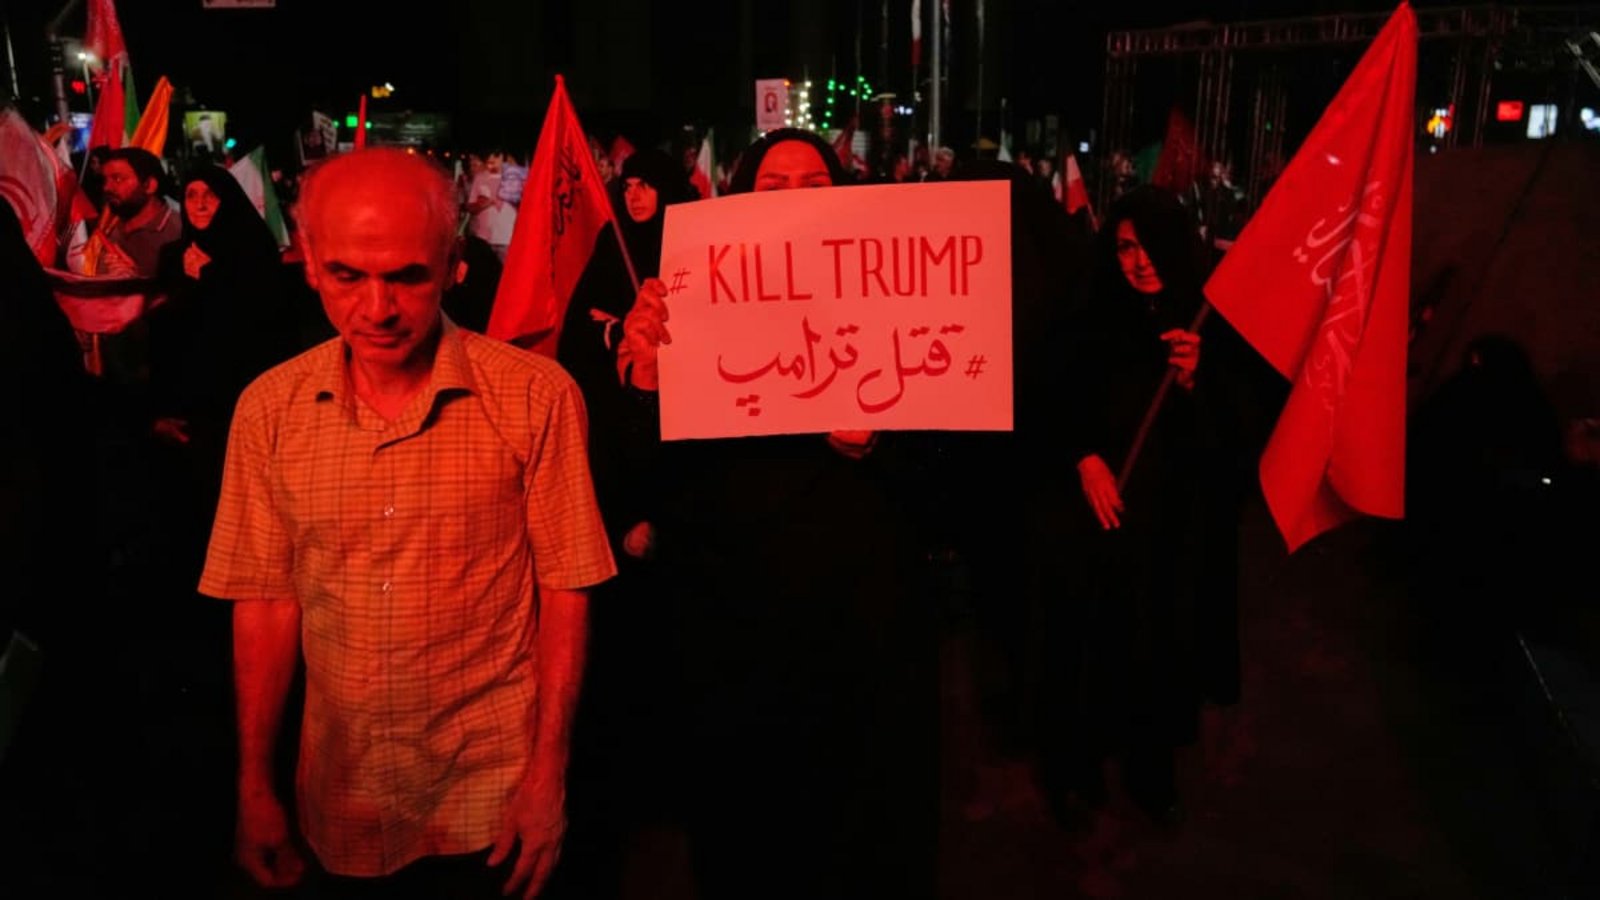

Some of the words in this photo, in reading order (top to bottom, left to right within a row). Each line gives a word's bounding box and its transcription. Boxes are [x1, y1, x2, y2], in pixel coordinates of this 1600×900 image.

[708, 242, 813, 304] KILL
[821, 235, 984, 299] TRUMP
[717, 315, 860, 418] ترامپ
